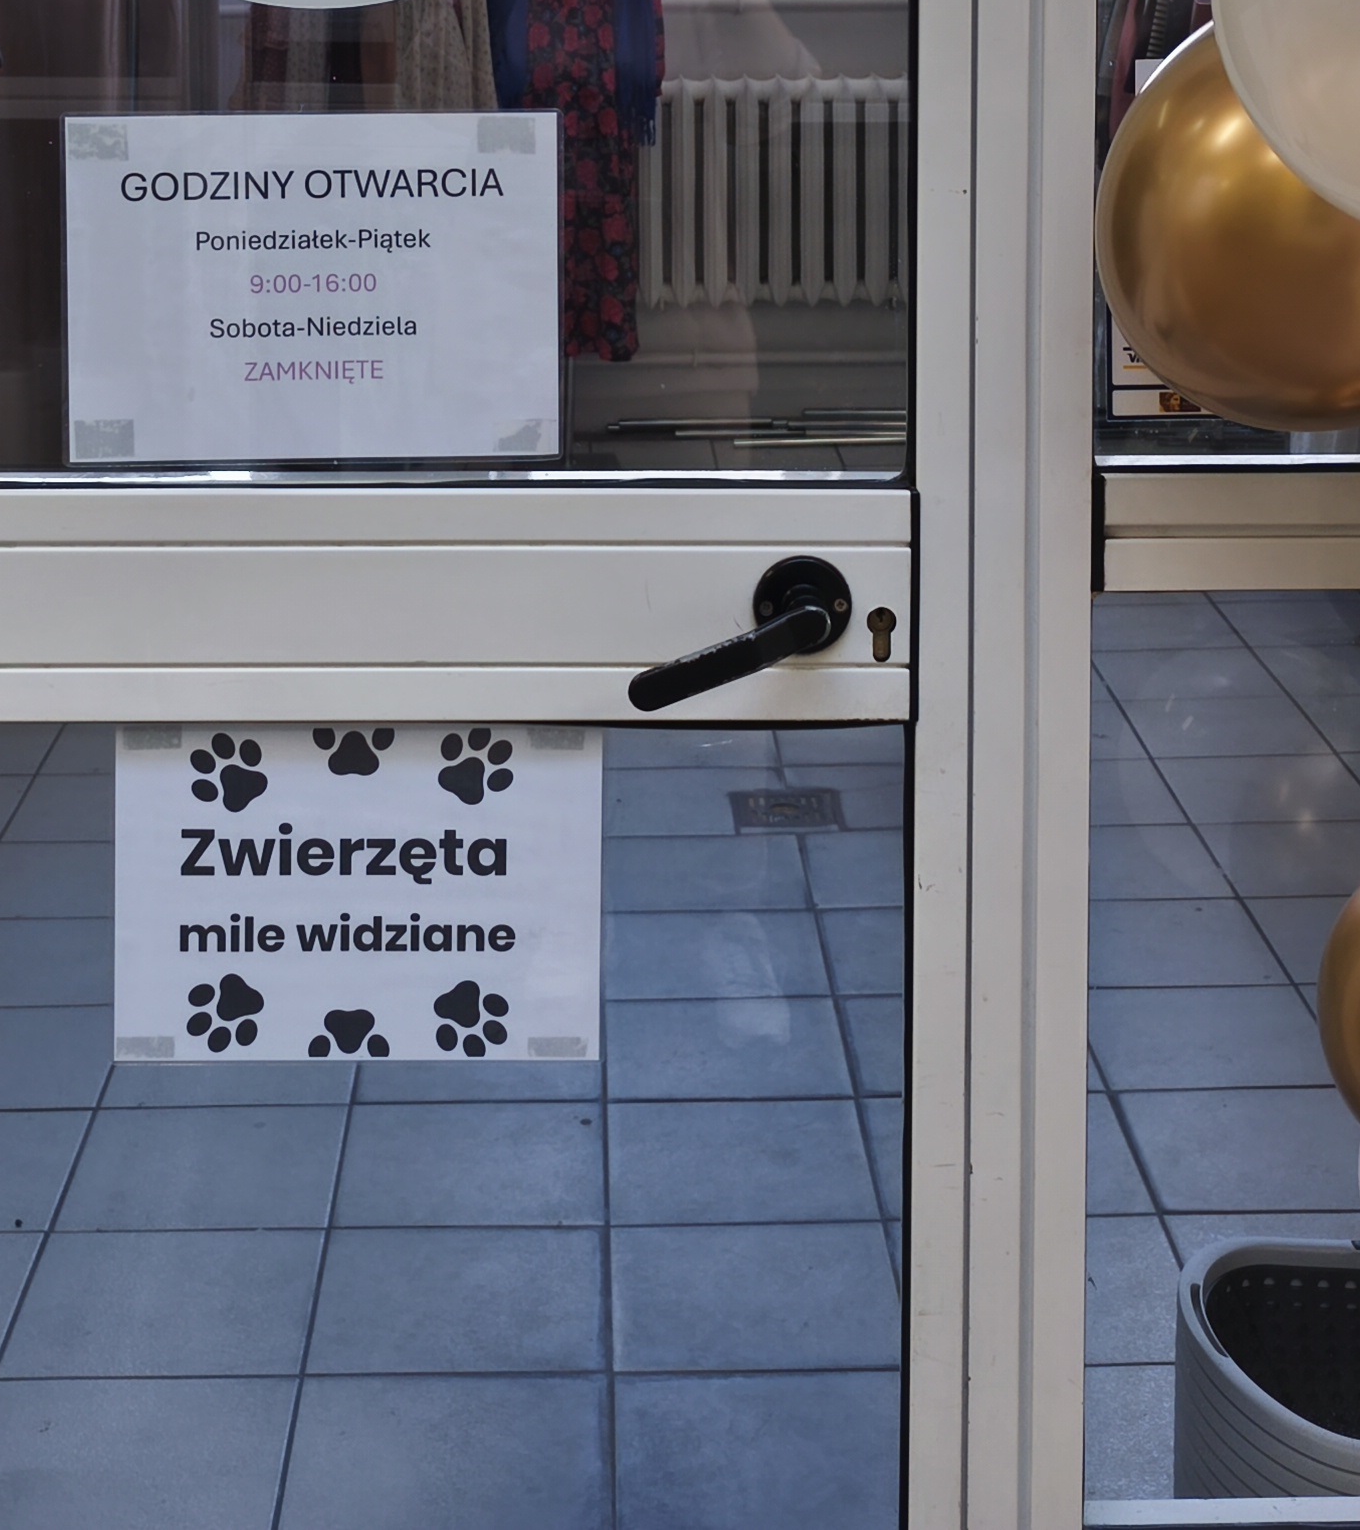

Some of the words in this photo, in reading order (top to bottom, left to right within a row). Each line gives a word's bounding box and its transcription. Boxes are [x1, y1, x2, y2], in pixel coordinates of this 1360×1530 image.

[120, 170, 295, 203] GODZINY
[304, 167, 504, 199] OTWARCIA
[196, 228, 431, 254] Poniedziałek-Piątek
[250, 273, 378, 294] 9:00-16:00
[209, 314, 418, 340] Sobota-Niedziela
[244, 360, 384, 384] ZAMKNIĘTE
[180, 822, 508, 884] Zwierzęta
[179, 913, 286, 953] mile
[297, 912, 516, 953] widziane
